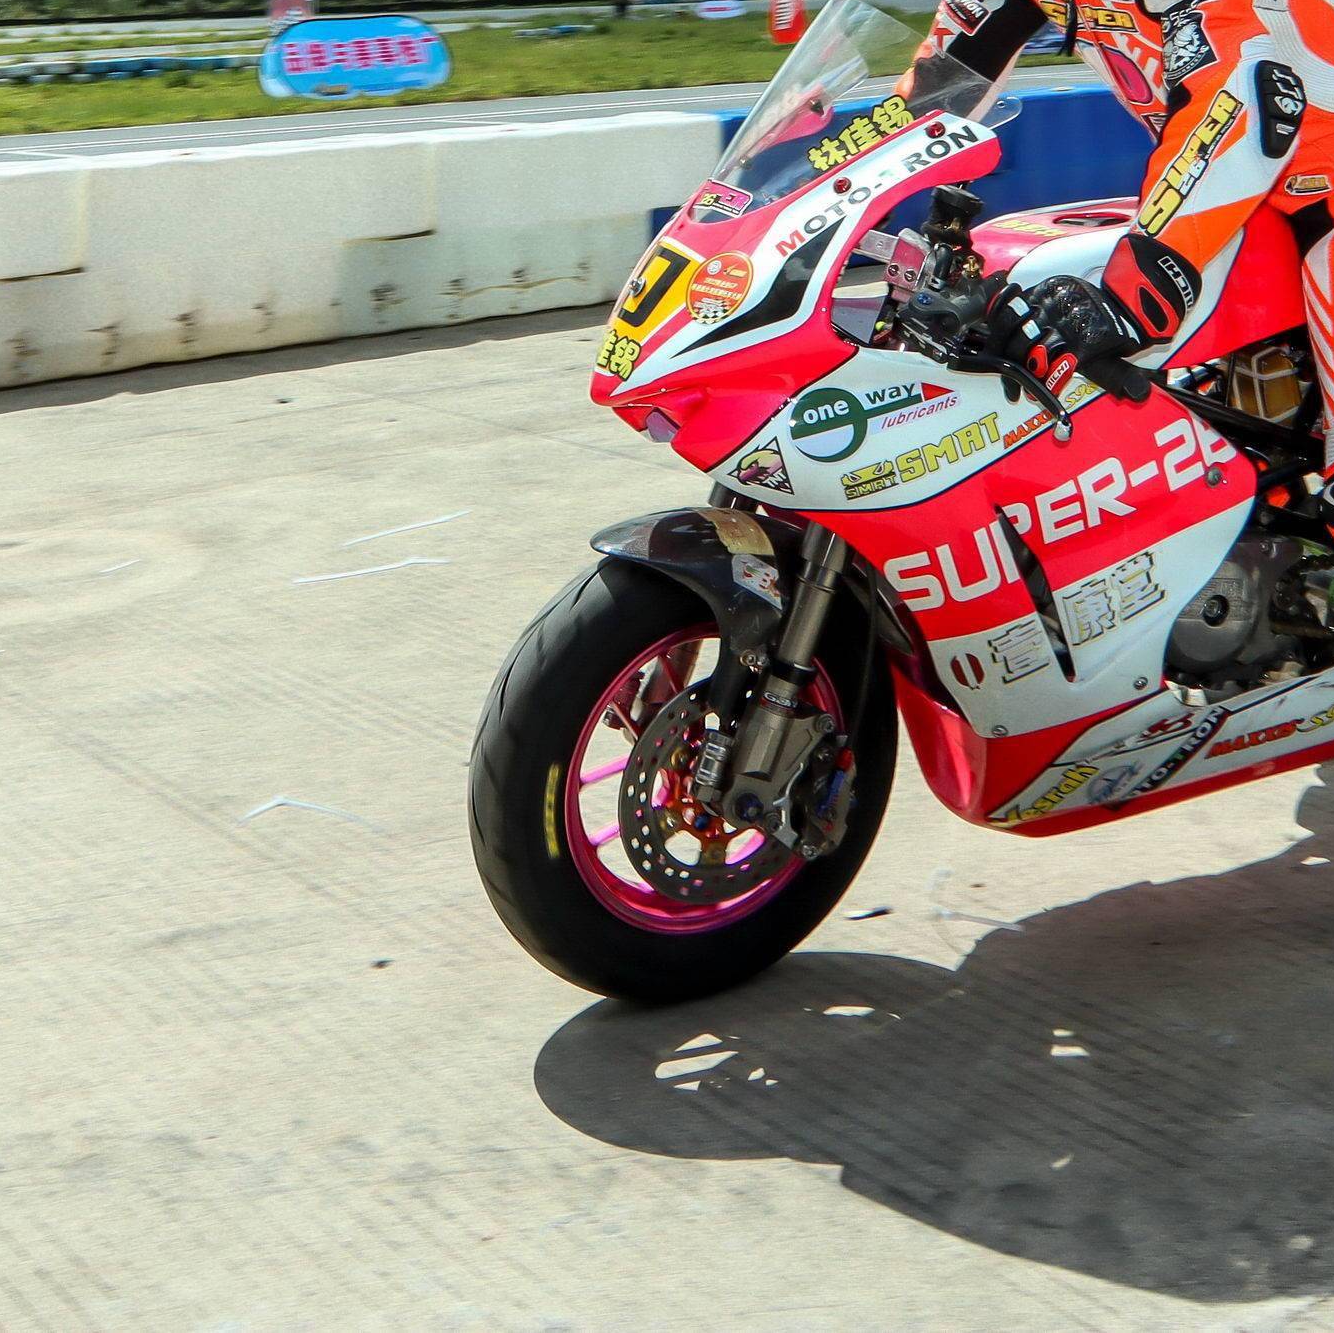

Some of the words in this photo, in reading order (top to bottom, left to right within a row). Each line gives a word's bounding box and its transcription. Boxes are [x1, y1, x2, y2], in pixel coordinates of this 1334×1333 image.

[1138, 92, 1239, 234] SUPER
[803, 400, 850, 424] one
[865, 383, 916, 404] way
[881, 396, 958, 429] lubricants
[1003, 409, 1053, 449] MAXXI
